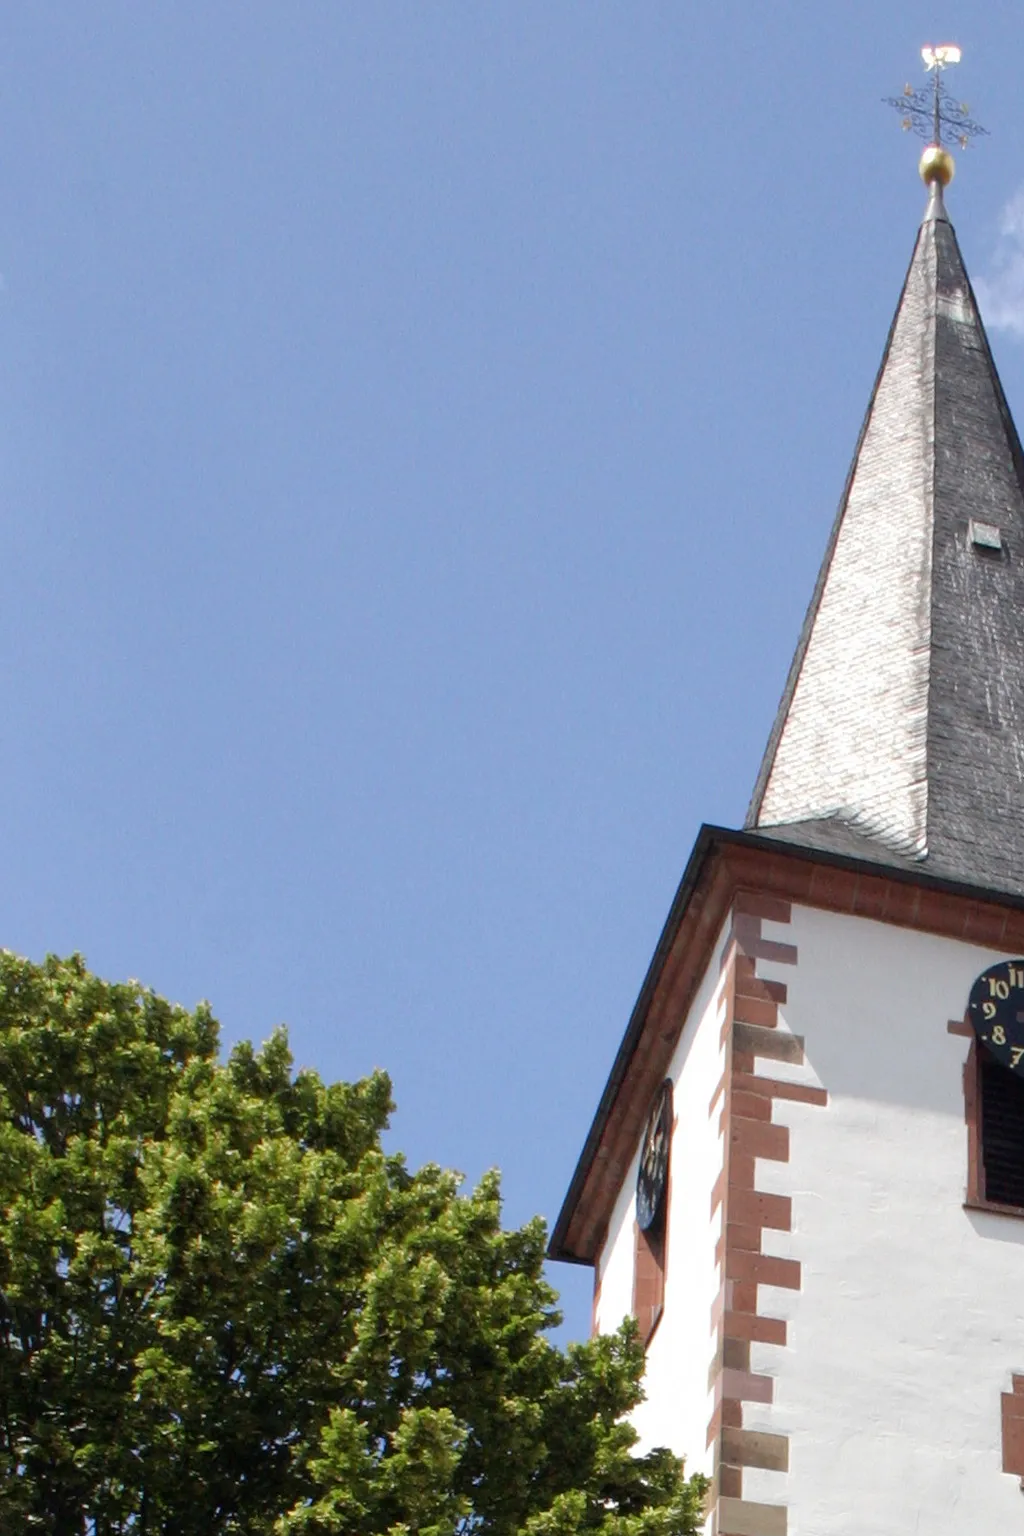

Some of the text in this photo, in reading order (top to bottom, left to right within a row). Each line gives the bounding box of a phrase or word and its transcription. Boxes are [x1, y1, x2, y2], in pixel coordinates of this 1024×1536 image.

[1009, 968, 1024, 988] 11
[989, 978, 1009, 999] 10
[983, 1003, 996, 1019] 9
[992, 1026, 1006, 1045] 8
[1010, 1047, 1024, 1064] 7
